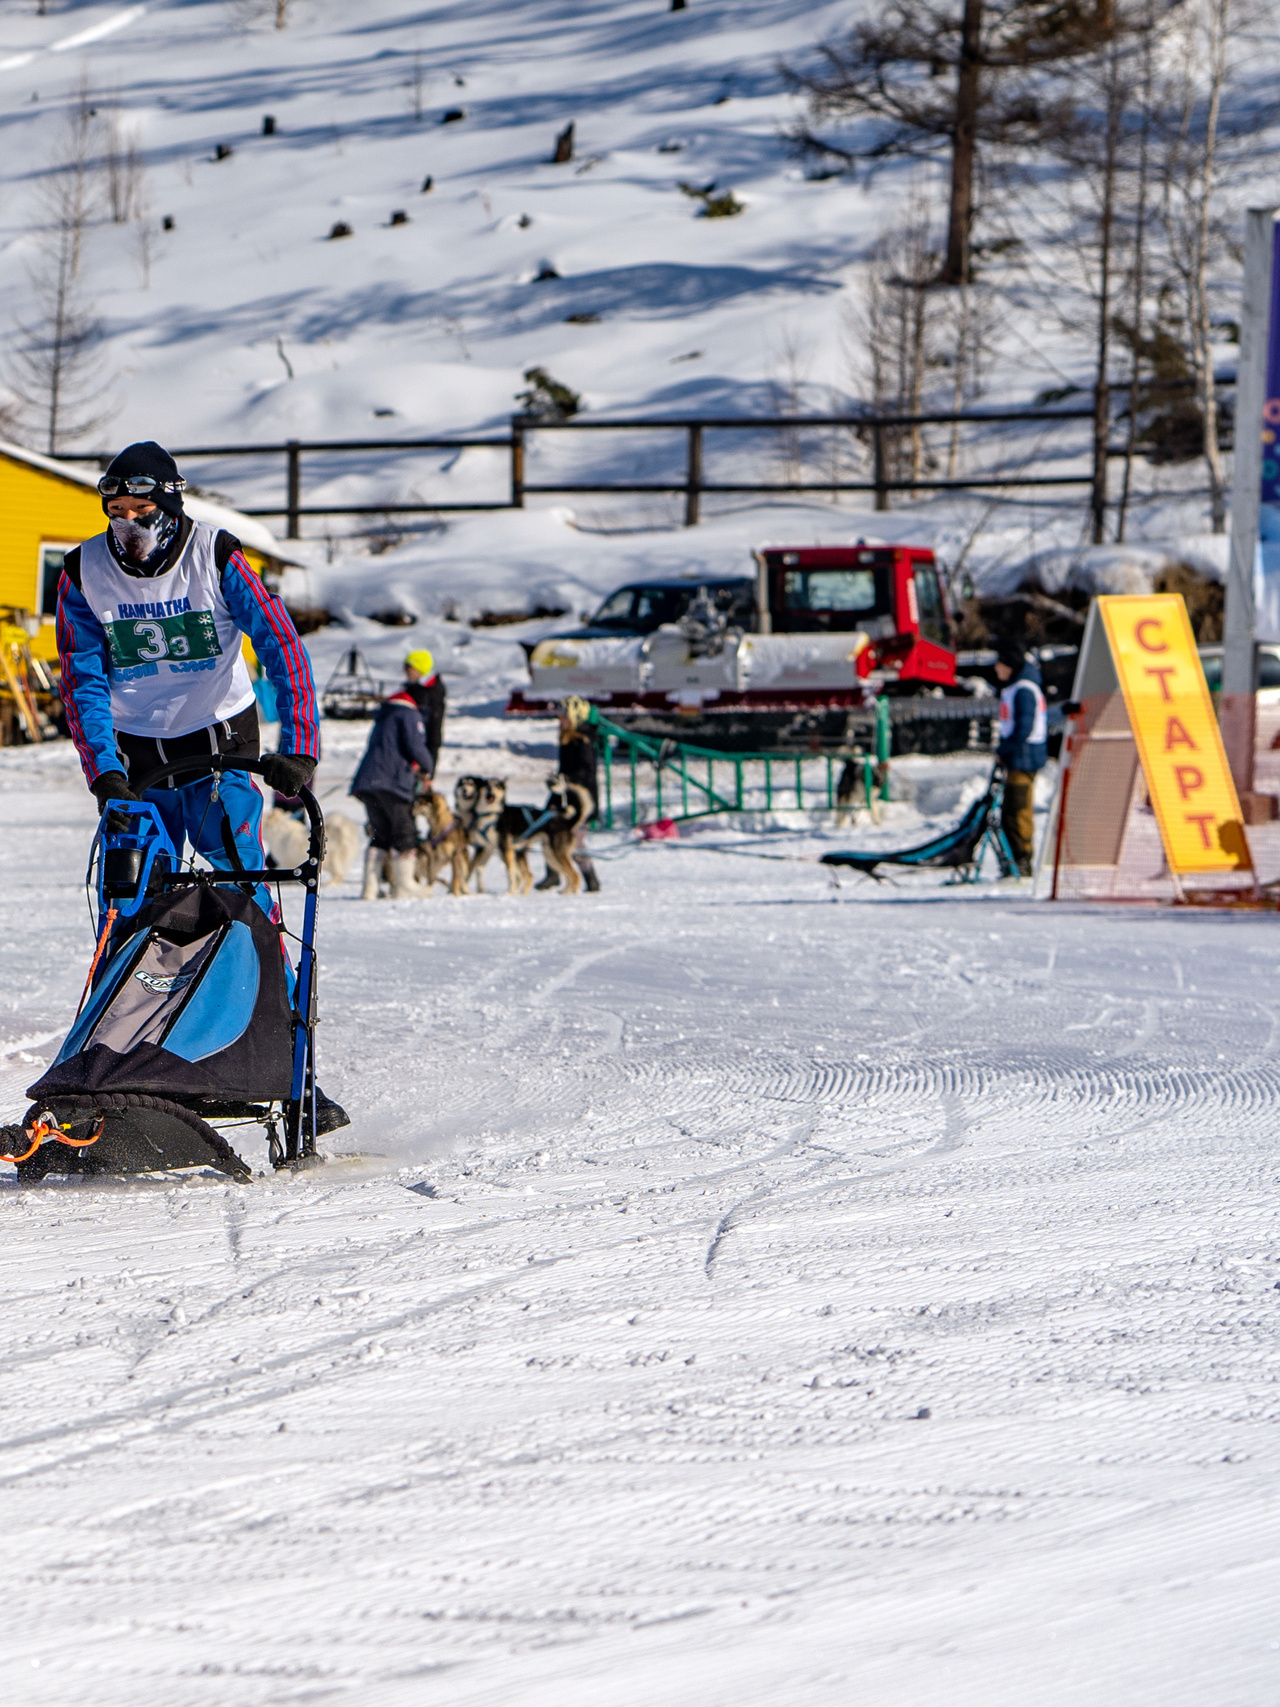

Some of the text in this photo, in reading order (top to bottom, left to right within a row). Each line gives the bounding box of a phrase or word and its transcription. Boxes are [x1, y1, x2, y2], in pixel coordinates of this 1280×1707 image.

[118, 597, 192, 619] КАМЧАТКА
[114, 662, 159, 683] БСОШ
[1134, 618, 1216, 850] СТАРТ
